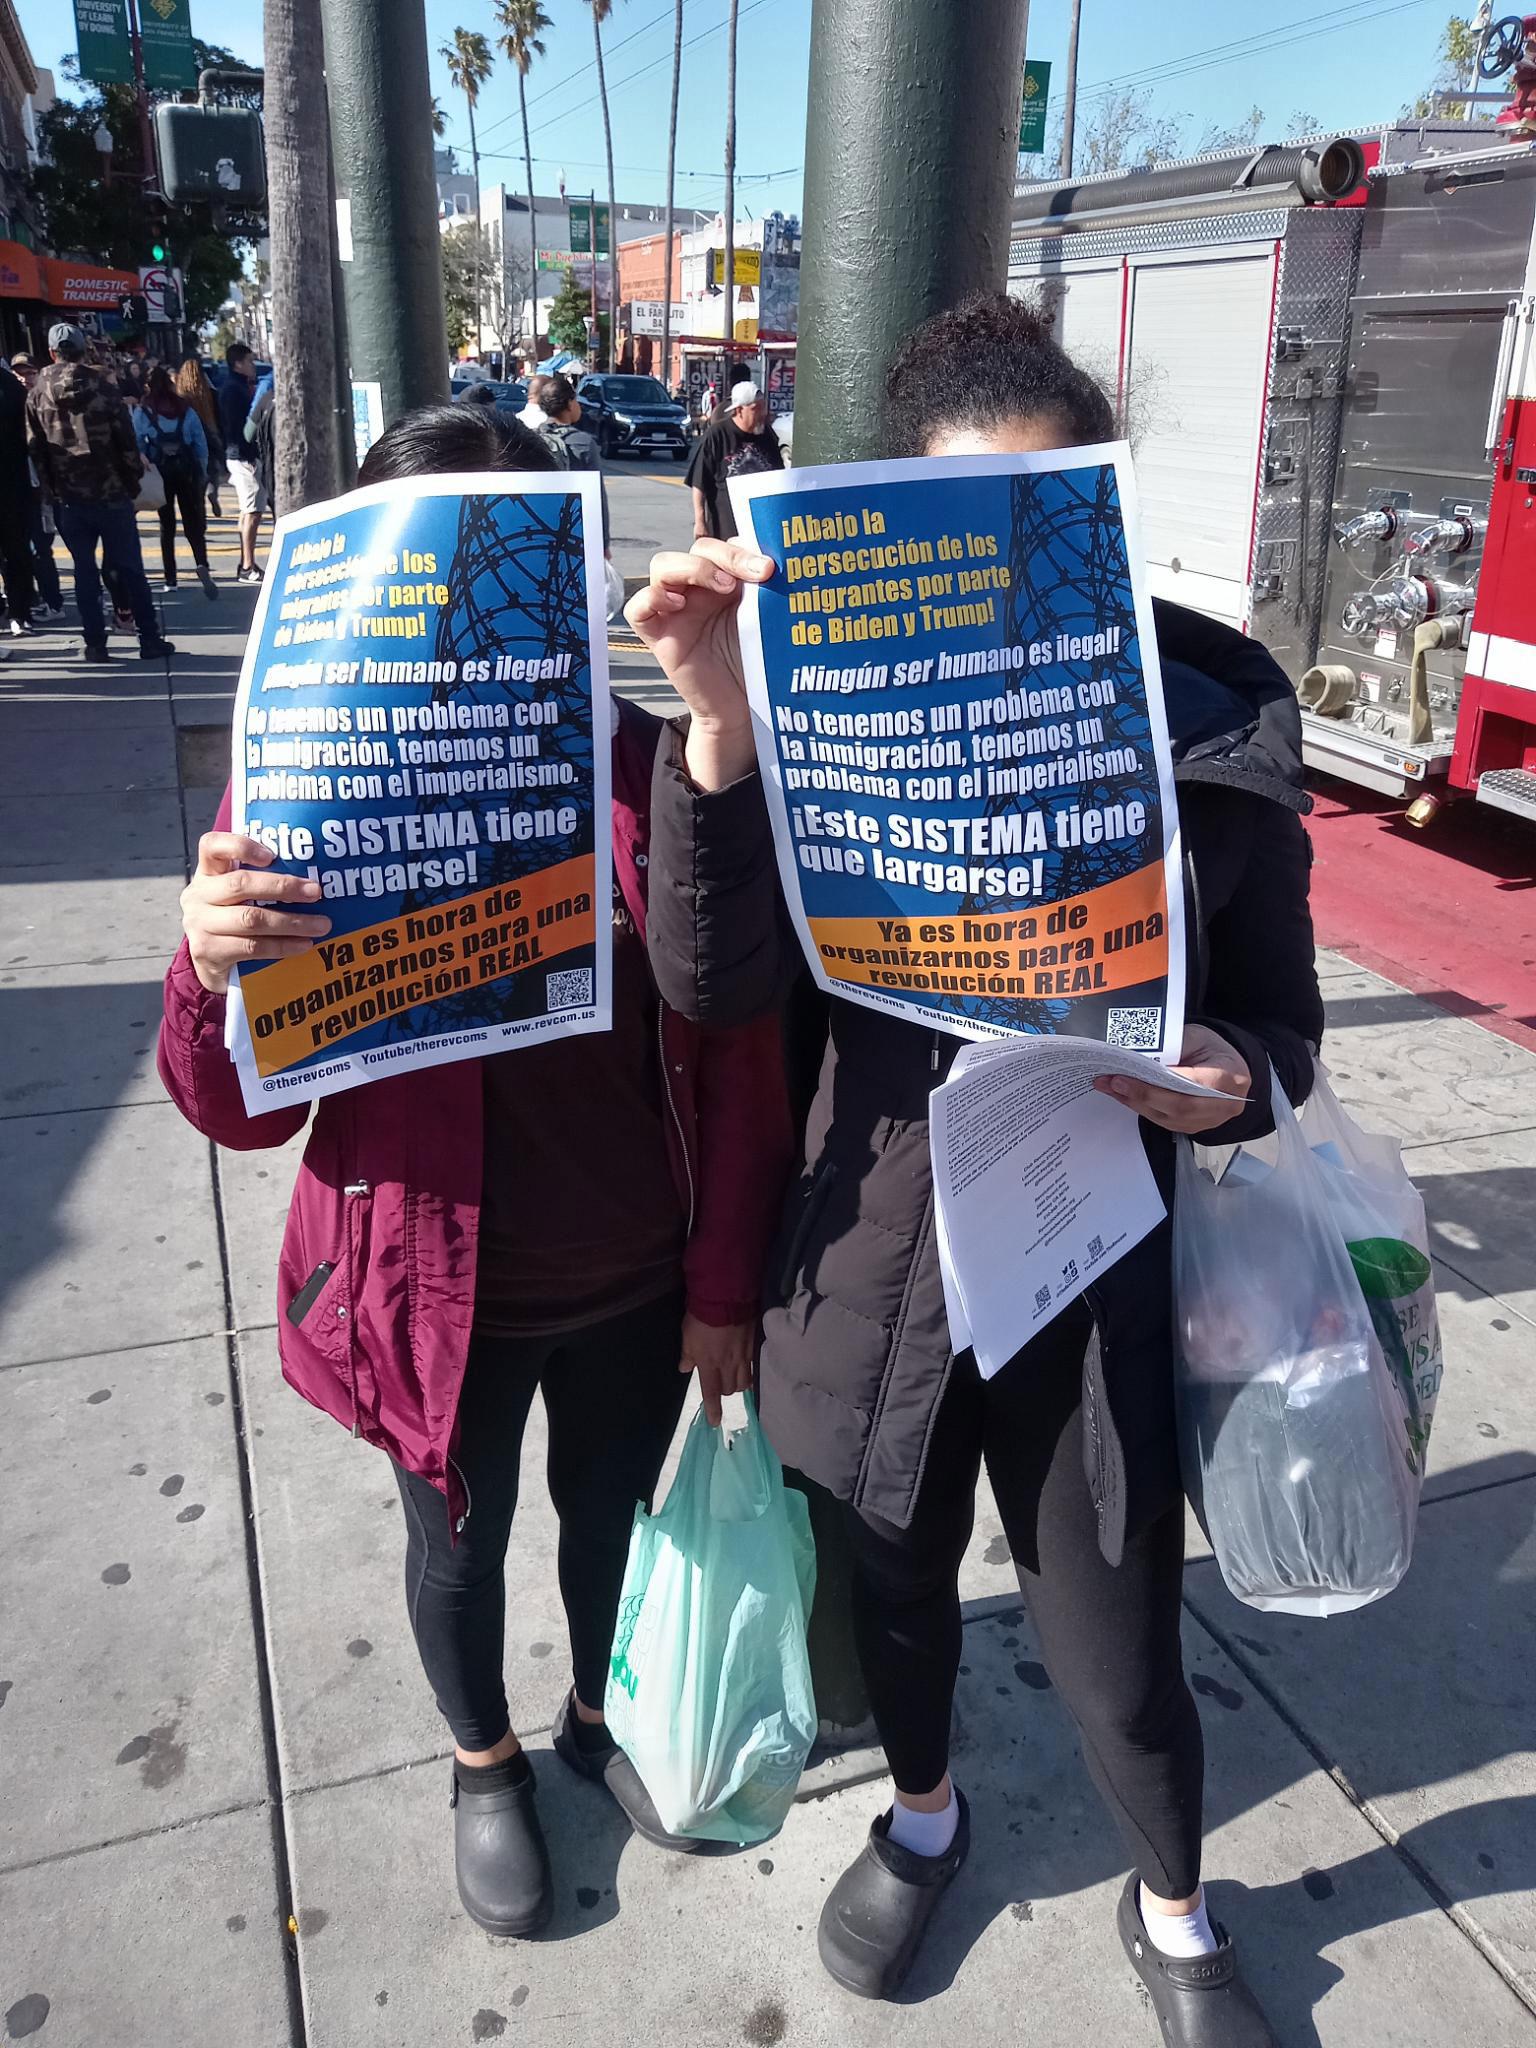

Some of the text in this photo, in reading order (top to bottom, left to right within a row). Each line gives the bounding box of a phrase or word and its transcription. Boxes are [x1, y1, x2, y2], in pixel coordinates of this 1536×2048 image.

[64, 278, 129, 291] DOMESTIC
[637, 307, 646, 317] EL
[691, 372, 722, 384] ONE
[782, 508, 887, 549] ¡Abajo la
[402, 549, 437, 575] los
[785, 531, 999, 584] persecución de los
[388, 582, 450, 609] parte
[788, 563, 1012, 615] migrantes por parte
[351, 611, 427, 641] Trump!
[791, 597, 997, 647] de Biden y Trump!
[325, 661, 361, 686] ser
[362, 656, 457, 685] humano
[461, 661, 490, 684] es
[493, 653, 571, 682] ilegal!
[790, 625, 1122, 697] ¡Ningún ser humano es ilegal!
[356, 706, 388, 733] un
[392, 701, 510, 733] problema
[514, 701, 559, 726] con
[775, 678, 1118, 739] No tenemos un problema con
[398, 735, 506, 766] tenemos
[509, 734, 541, 759] un
[780, 716, 1105, 772] la inmigración, tenemos un
[337, 774, 384, 801] con
[387, 769, 412, 797] el
[415, 761, 580, 796] imperialismo.
[786, 745, 1144, 803] problema con el imperialismo.
[320, 809, 480, 858] SISTEMA
[484, 805, 578, 843] tiene
[791, 799, 1147, 857] ¡Este SISTEMA tiene
[798, 842, 1045, 899] que largarse!
[316, 887, 522, 974] Ya es hora de
[819, 910, 1164, 973] organizarnos para una
[877, 901, 1090, 945] Ya es hora de
[254, 891, 593, 1041] organizarnos para una
[869, 961, 1109, 996] revolución REAL
[309, 935, 544, 1048] revolución REAL
[828, 977, 907, 1011] @therevcoms
[262, 1008, 597, 1093] @therevcoms Youtube/therevcoms www.revcom.us
